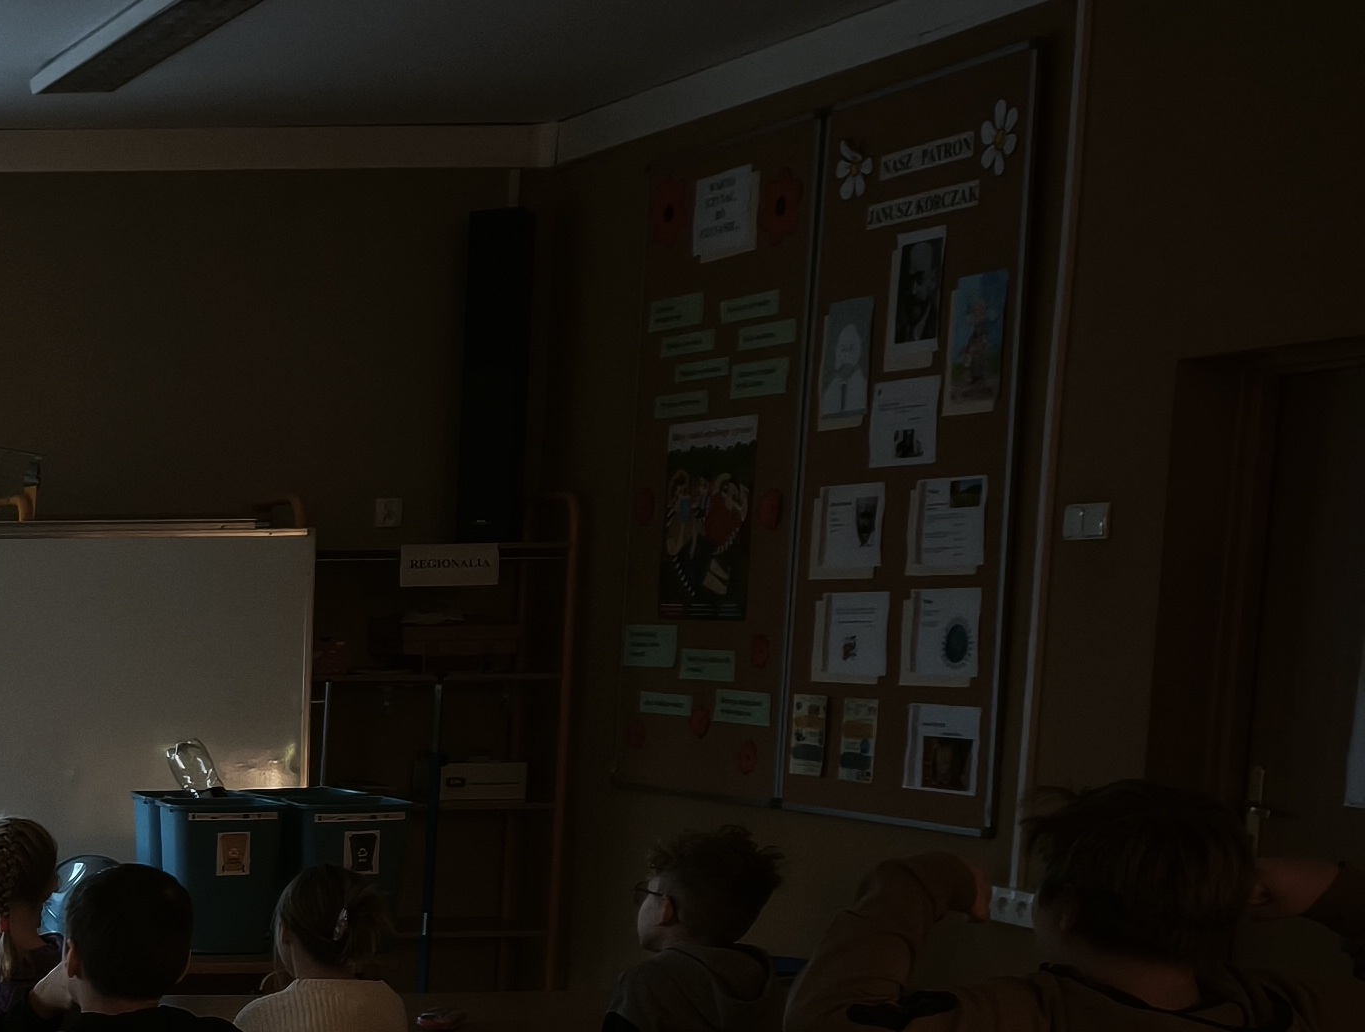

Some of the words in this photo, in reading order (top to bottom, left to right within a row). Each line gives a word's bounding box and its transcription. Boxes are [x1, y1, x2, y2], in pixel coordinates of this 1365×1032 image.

[920, 137, 972, 166] PATRON
[867, 201, 913, 225] JANUSZ
[915, 186, 980, 216] KORCZAK
[409, 558, 491, 569] REGIONALIA
